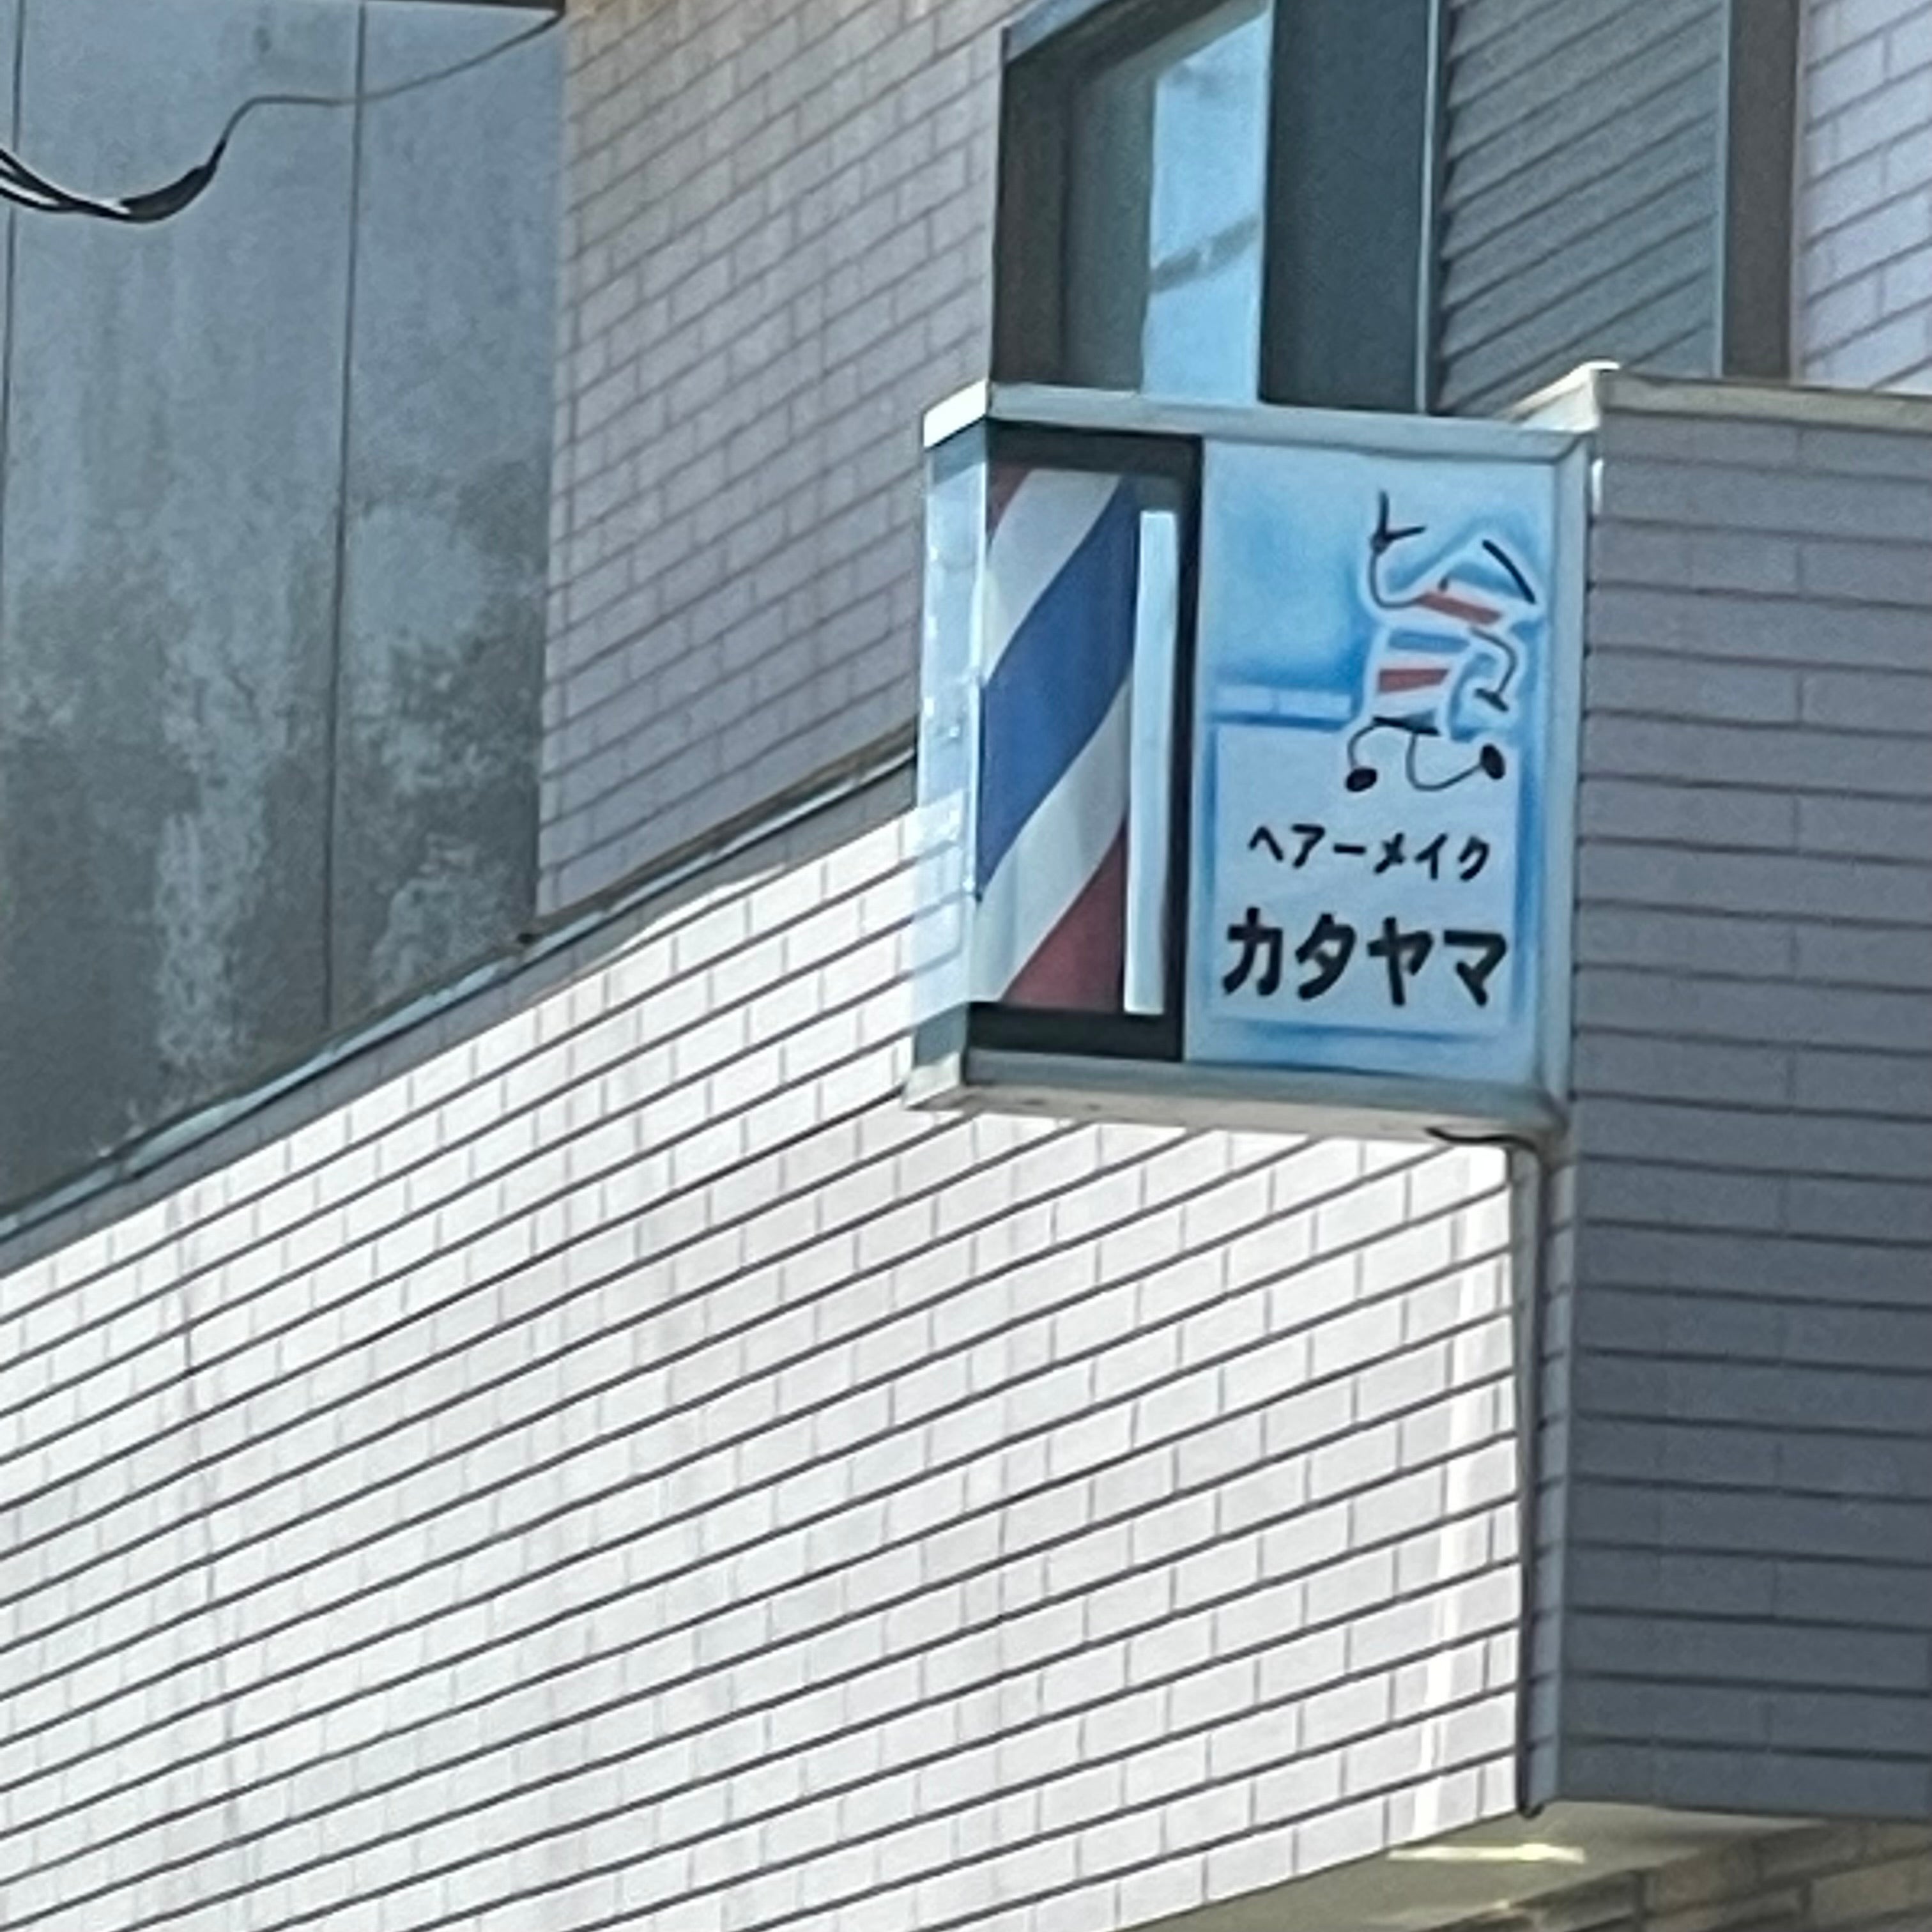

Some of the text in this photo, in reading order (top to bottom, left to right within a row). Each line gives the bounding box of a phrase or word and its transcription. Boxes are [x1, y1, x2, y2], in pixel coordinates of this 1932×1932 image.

[1248, 824, 1490, 881] ヘアーメイク
[1222, 907, 1506, 1007] カタヤマ
